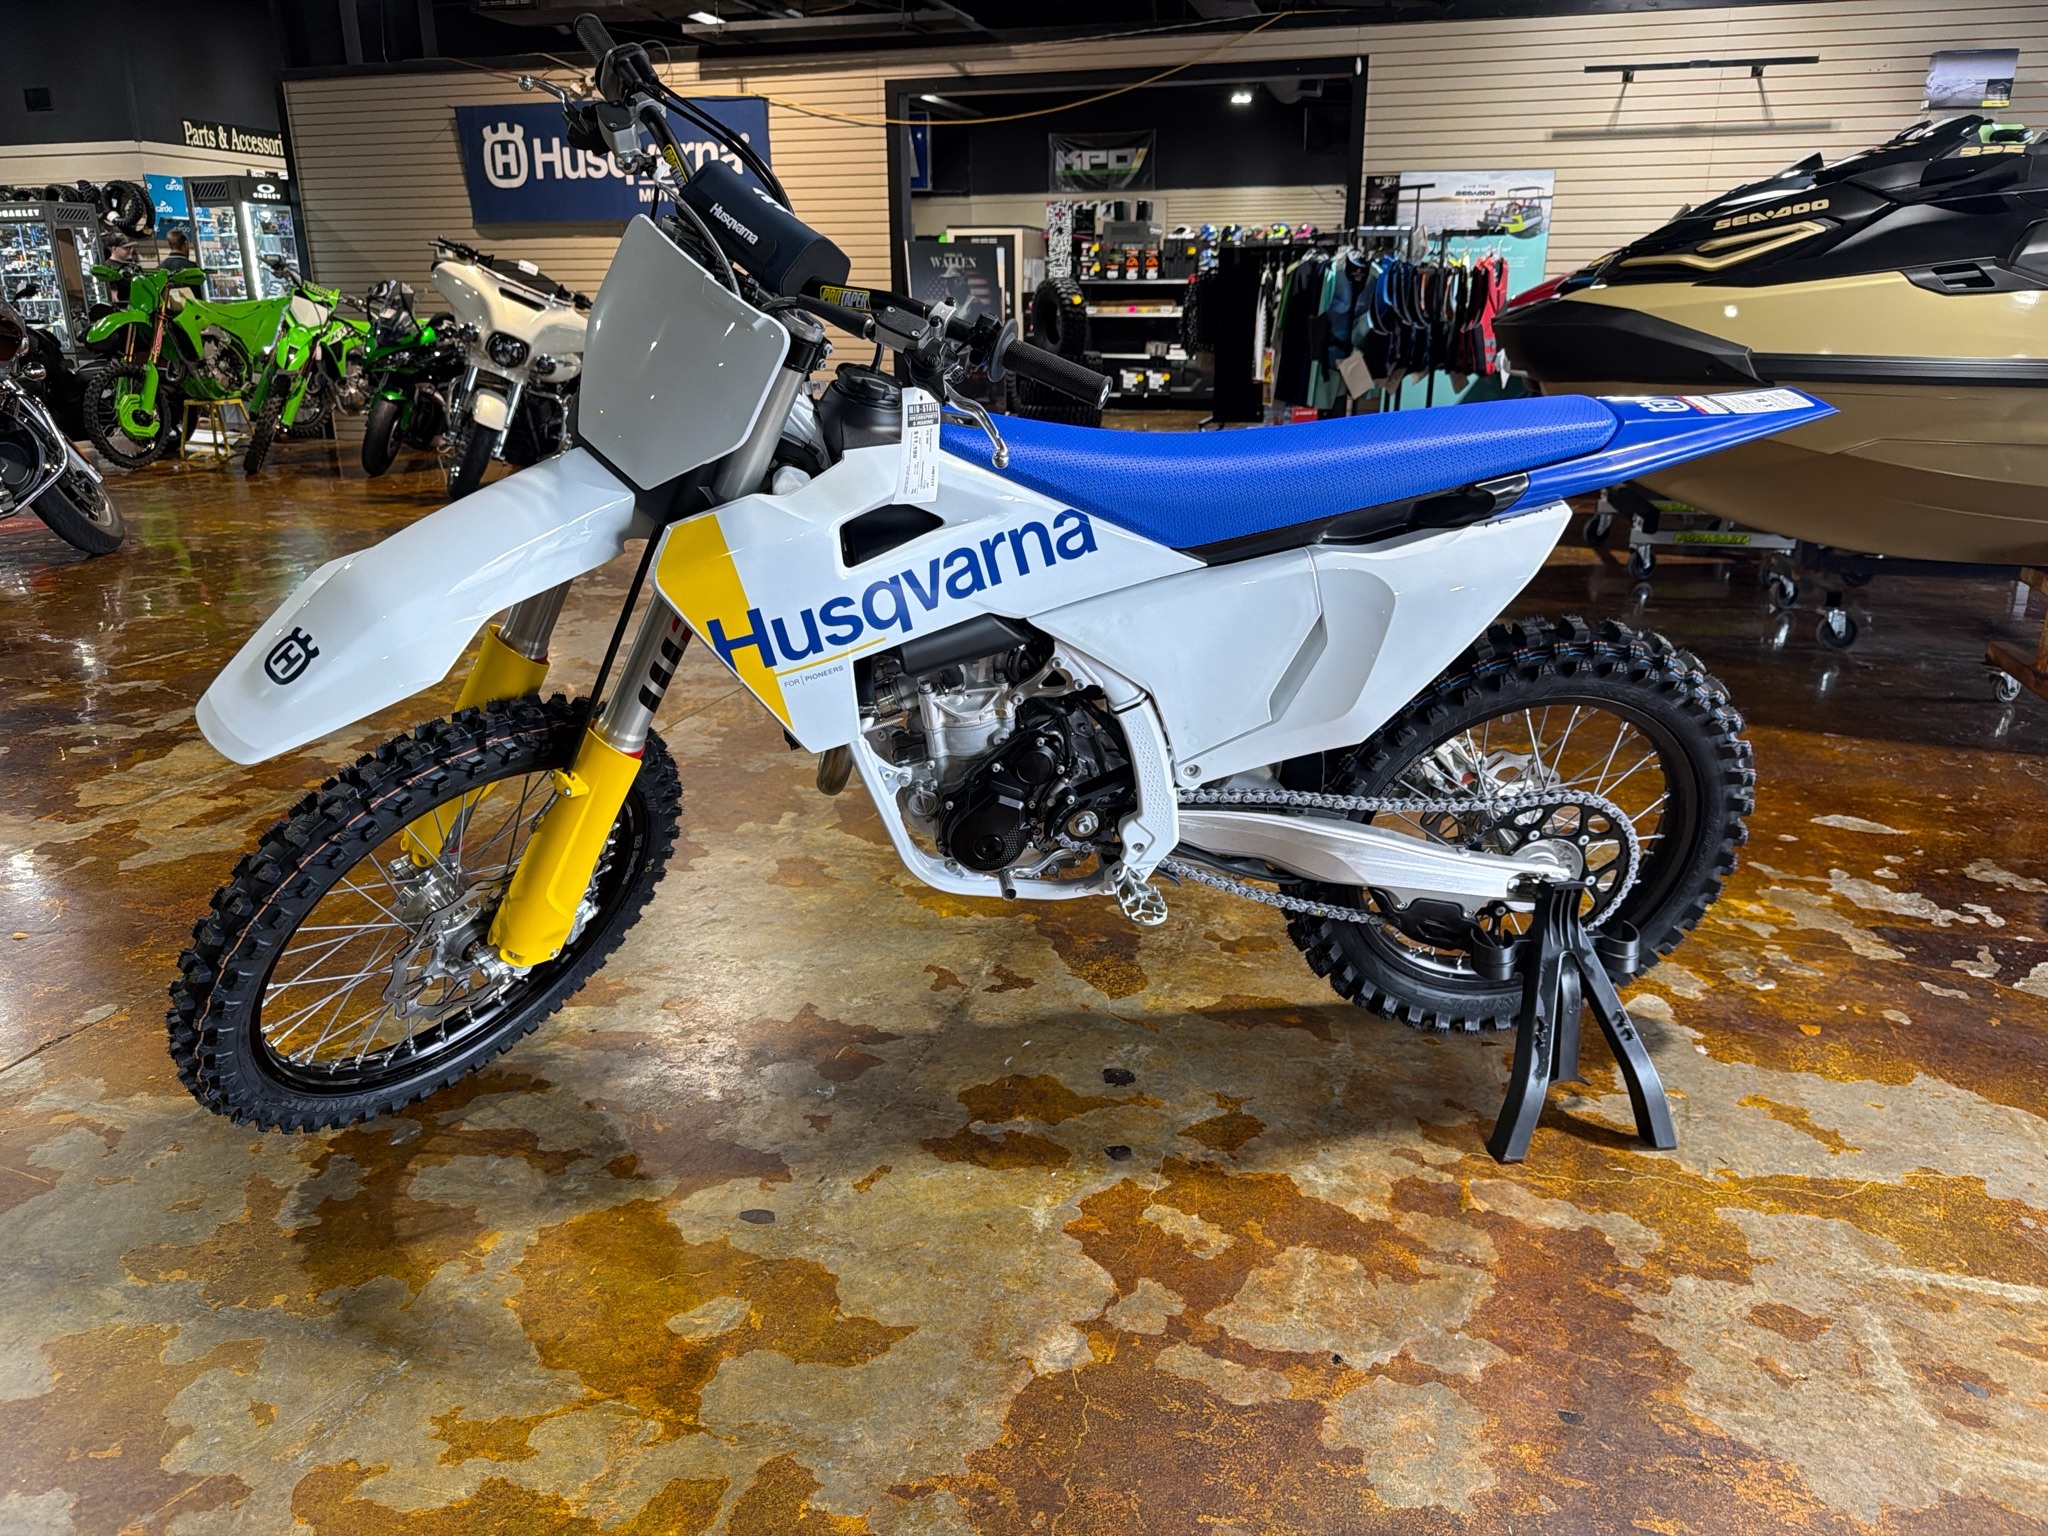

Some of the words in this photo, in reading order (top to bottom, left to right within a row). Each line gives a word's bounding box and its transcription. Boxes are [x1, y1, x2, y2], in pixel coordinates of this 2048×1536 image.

[183, 121, 216, 148] Parts
[218, 125, 229, 149] &
[231, 127, 284, 156] Accessori
[253, 192, 281, 200] OAKLEY
[3, 209, 39, 218] OAKLEY
[709, 202, 759, 246] Husqvarna
[908, 402, 938, 414] MID-STATE
[706, 508, 1099, 674] Husqvarna
[784, 678, 800, 688] FOR
[804, 665, 844, 682] PIONEERS
